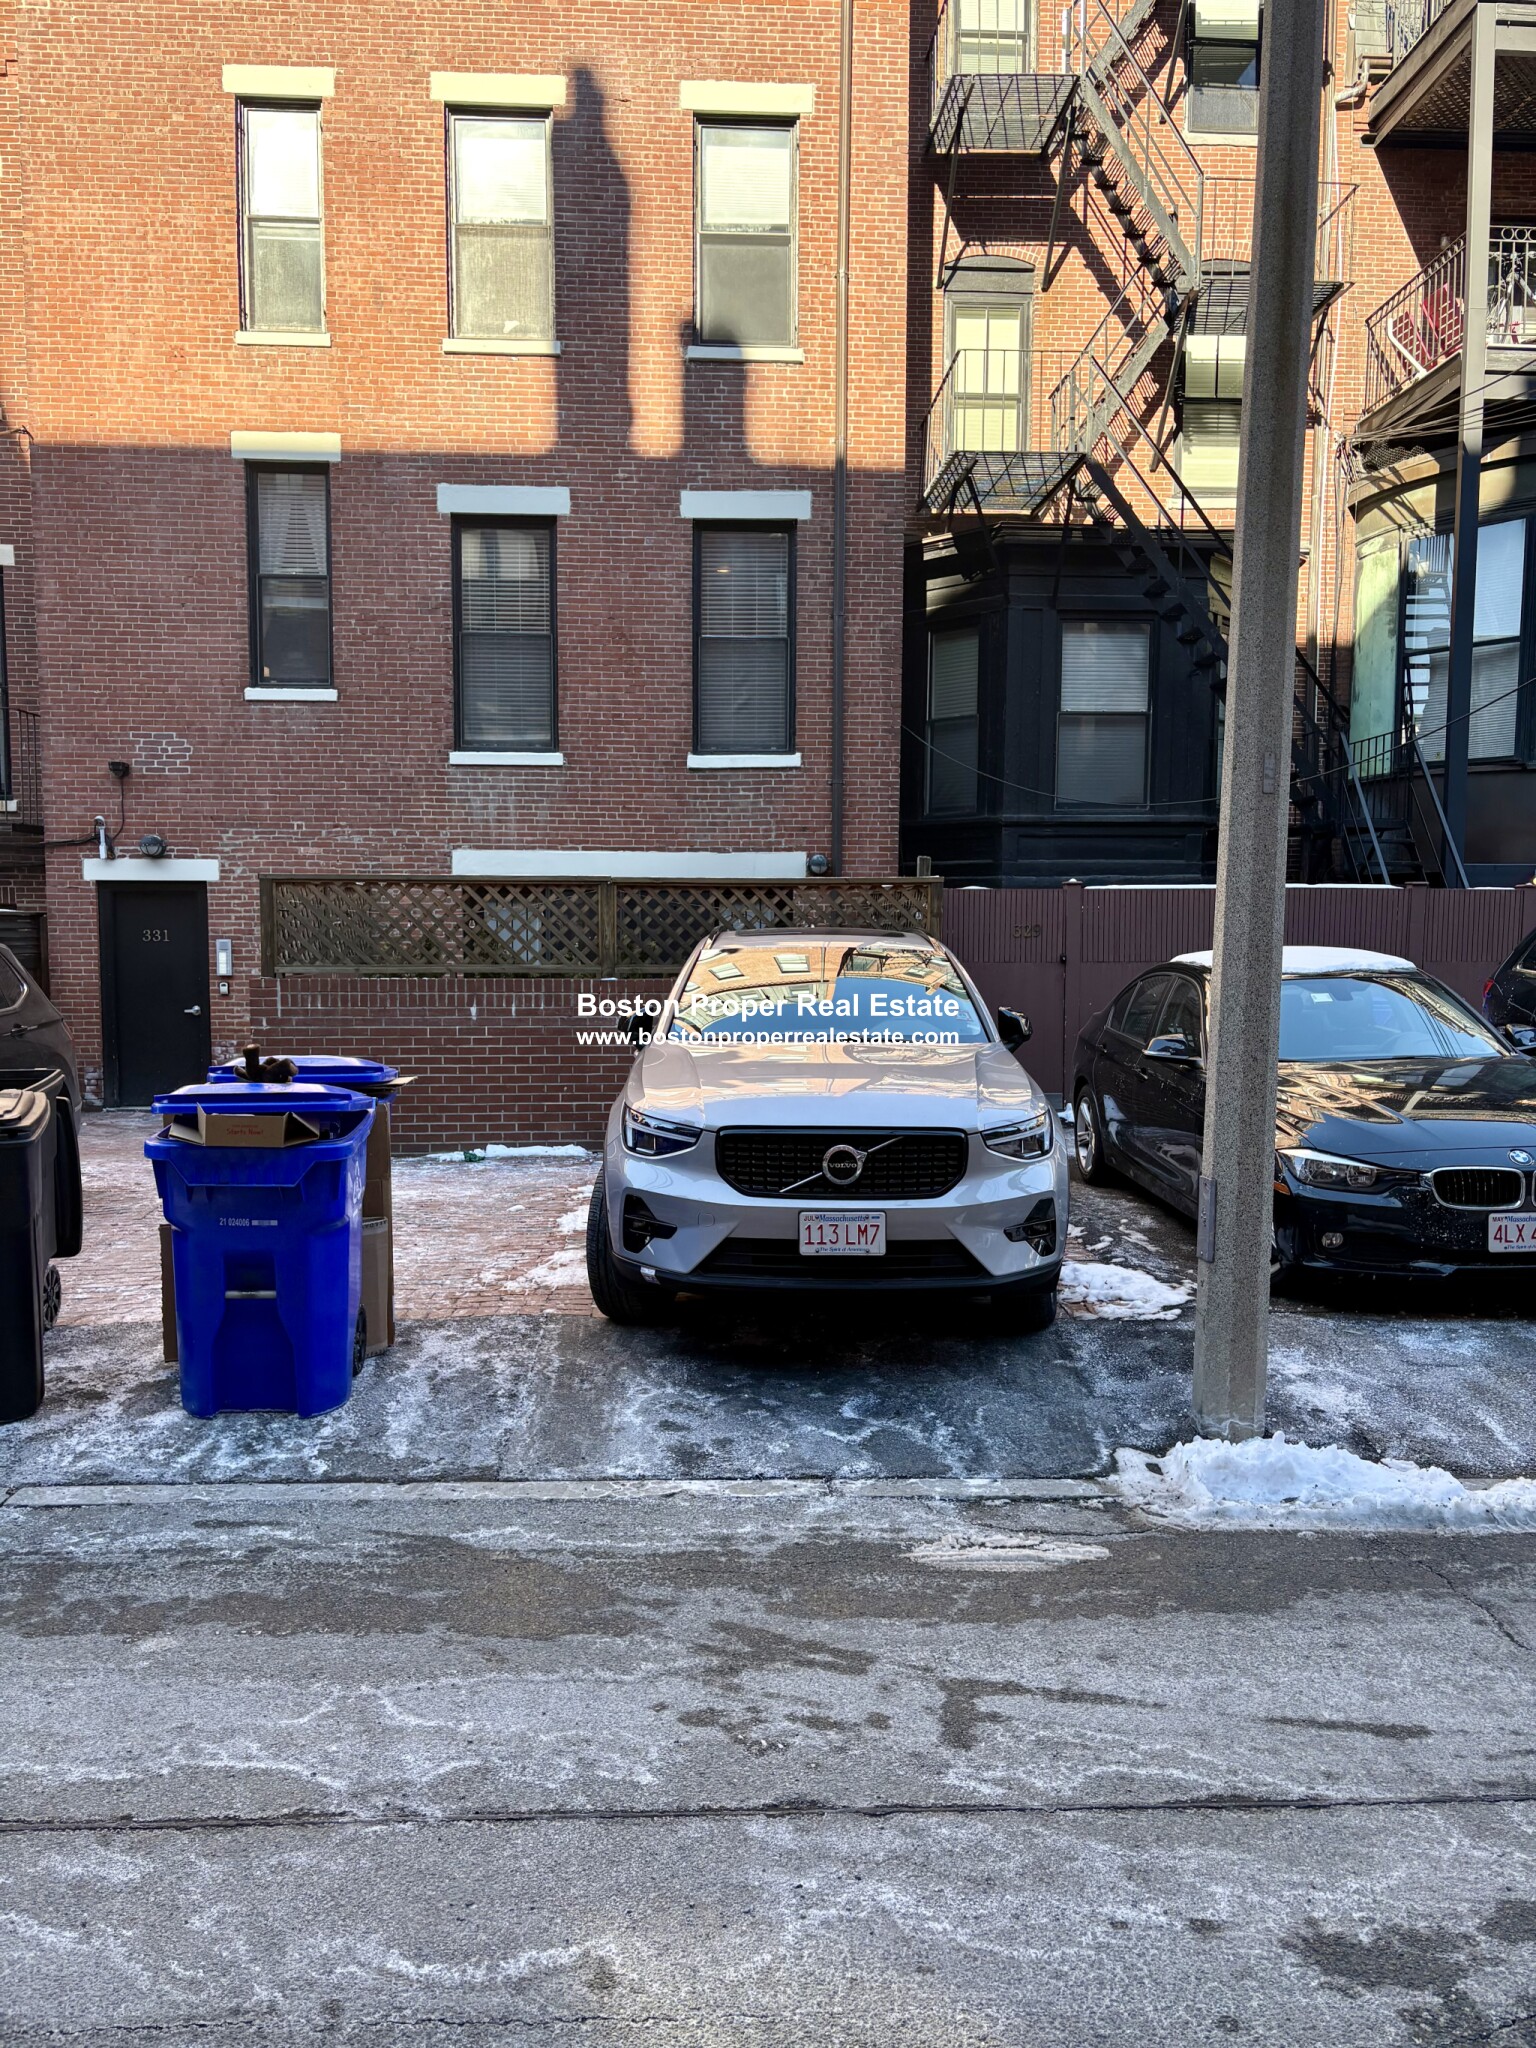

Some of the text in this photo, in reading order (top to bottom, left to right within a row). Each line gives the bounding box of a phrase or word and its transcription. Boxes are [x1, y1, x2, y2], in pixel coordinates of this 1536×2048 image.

[142, 929, 170, 942] 331
[1012, 924, 1042, 939] 329
[818, 1214, 867, 1222] Massachusetts
[804, 1223, 880, 1245] 113 LM7
[1493, 1224, 1525, 1243] 4LX
